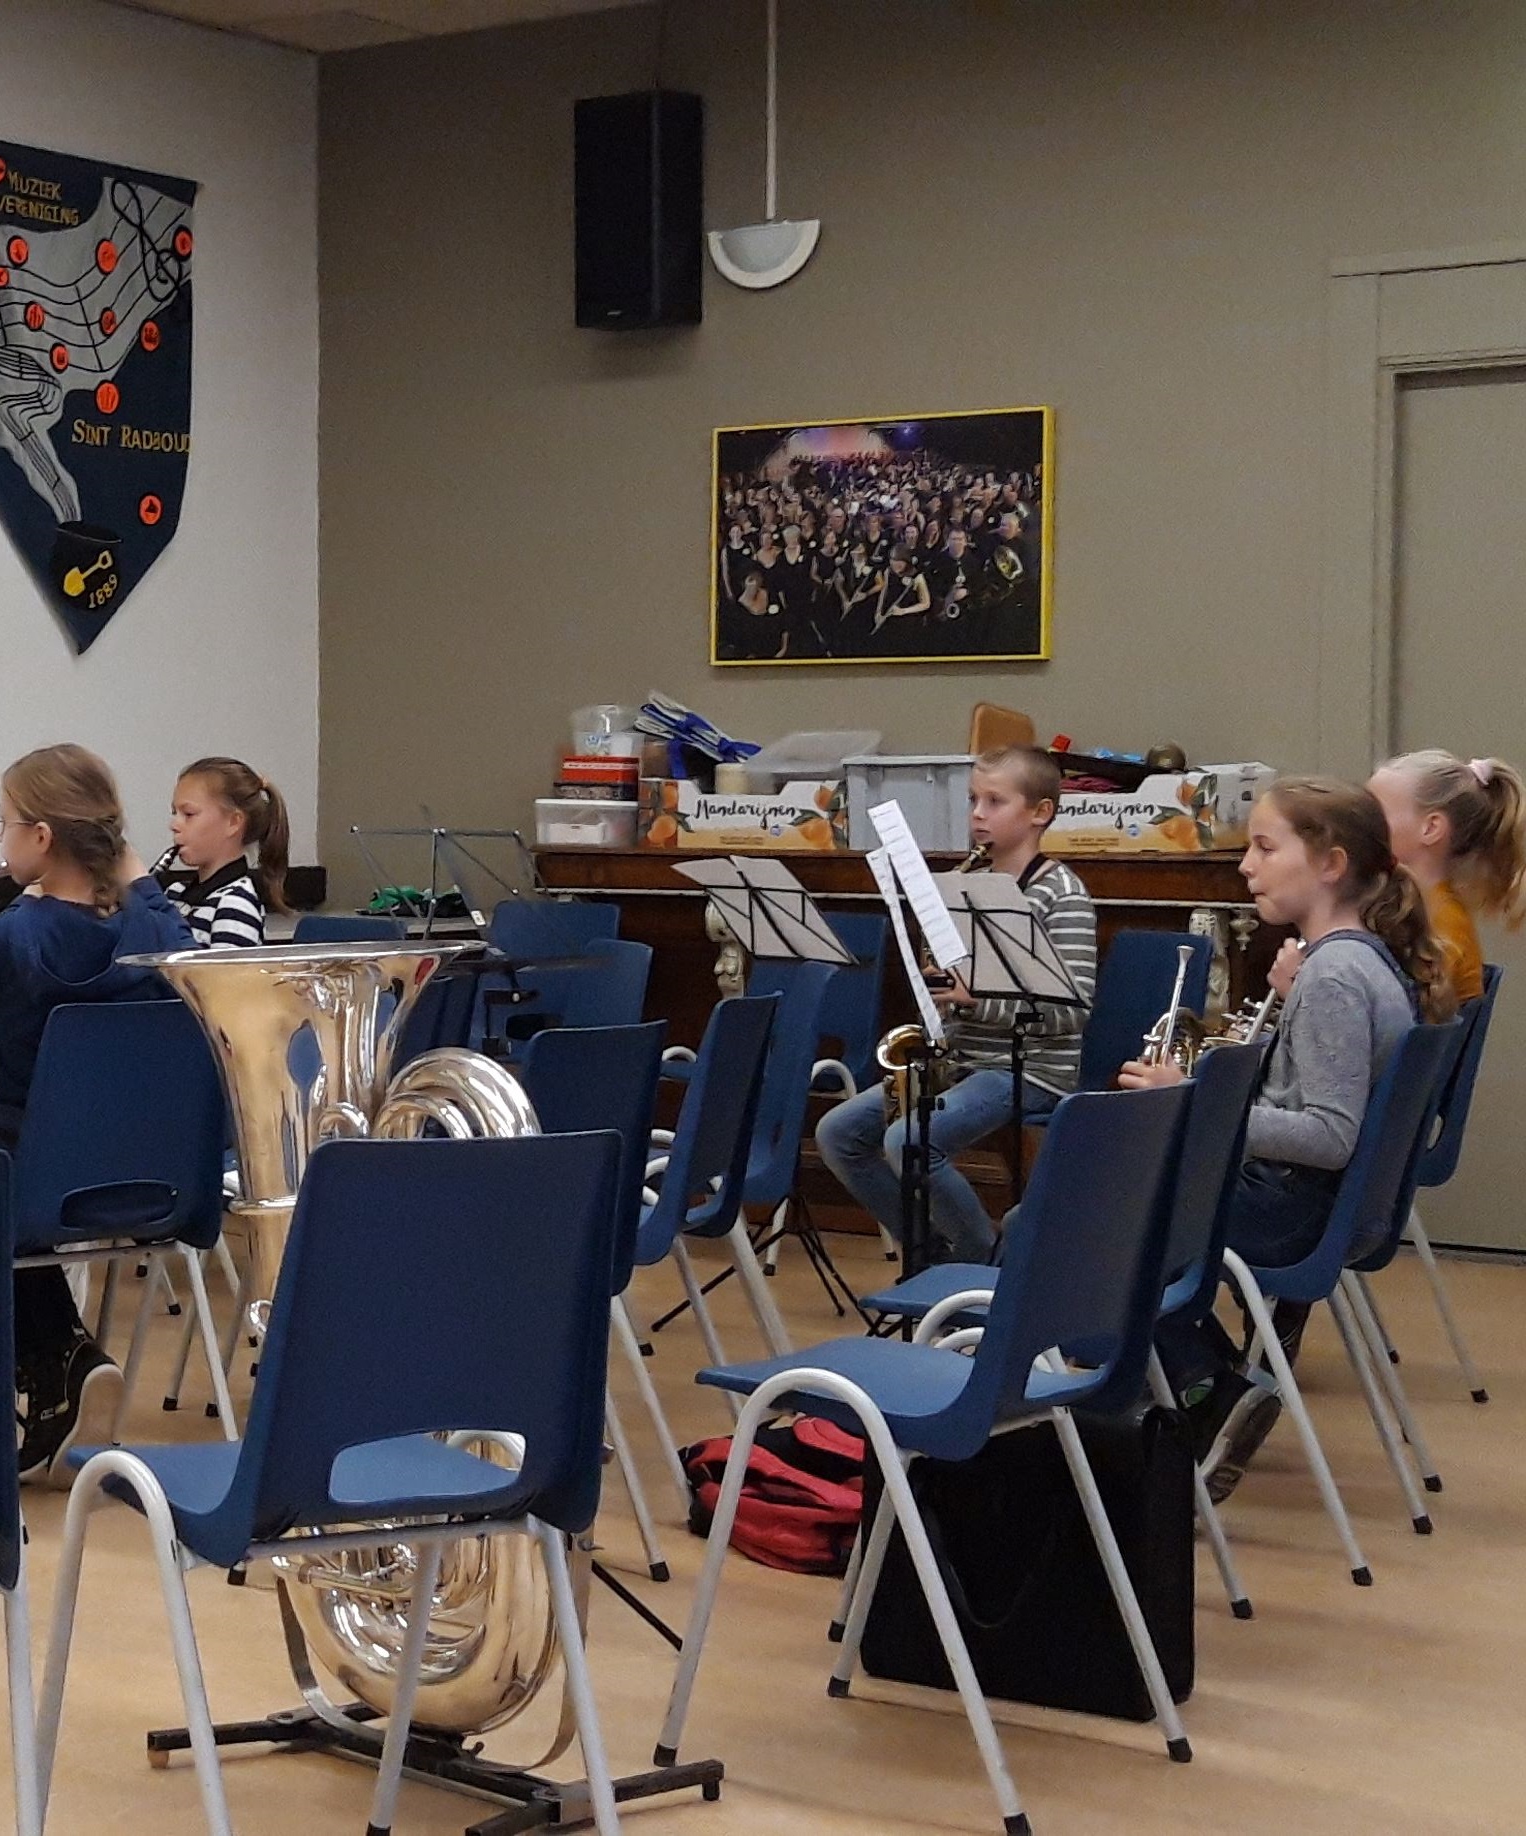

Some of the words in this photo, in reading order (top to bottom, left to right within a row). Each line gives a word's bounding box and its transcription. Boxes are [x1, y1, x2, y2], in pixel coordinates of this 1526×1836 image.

[8, 171, 62, 200] MUZIEK
[88, 573, 119, 609] 1889
[695, 799, 796, 831] Mandarijnen
[1056, 799, 1155, 830] andarijnen
